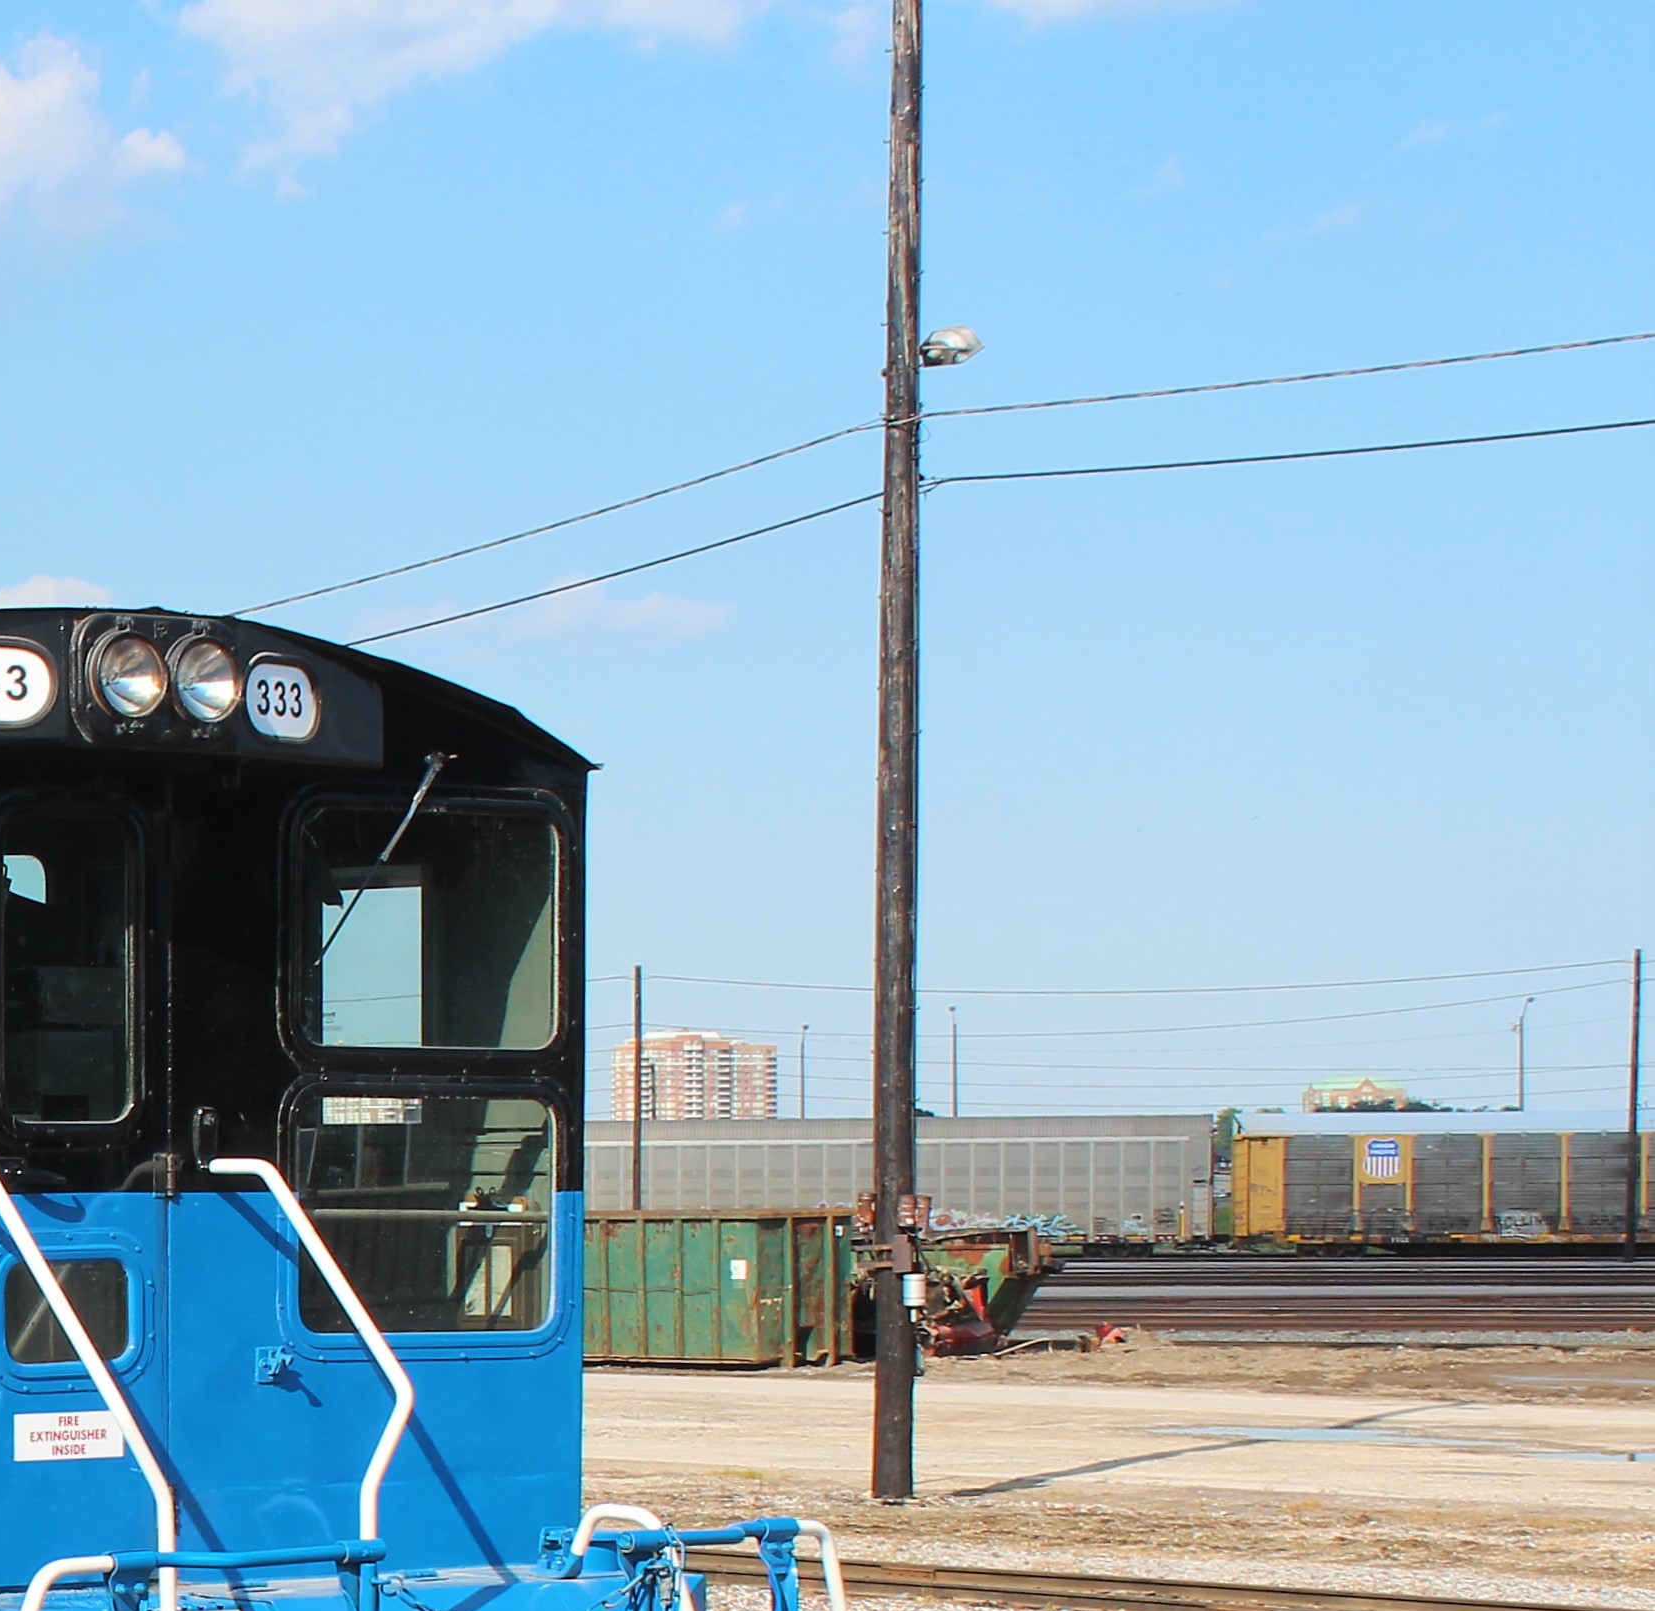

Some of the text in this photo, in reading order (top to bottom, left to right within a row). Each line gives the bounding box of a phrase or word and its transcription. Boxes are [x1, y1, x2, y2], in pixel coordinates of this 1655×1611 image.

[256, 679, 303, 718] 333
[58, 1415, 80, 1427] FIRE
[29, 1429, 108, 1443] EXTINGUISHER
[52, 1444, 87, 1456] INSIDE
